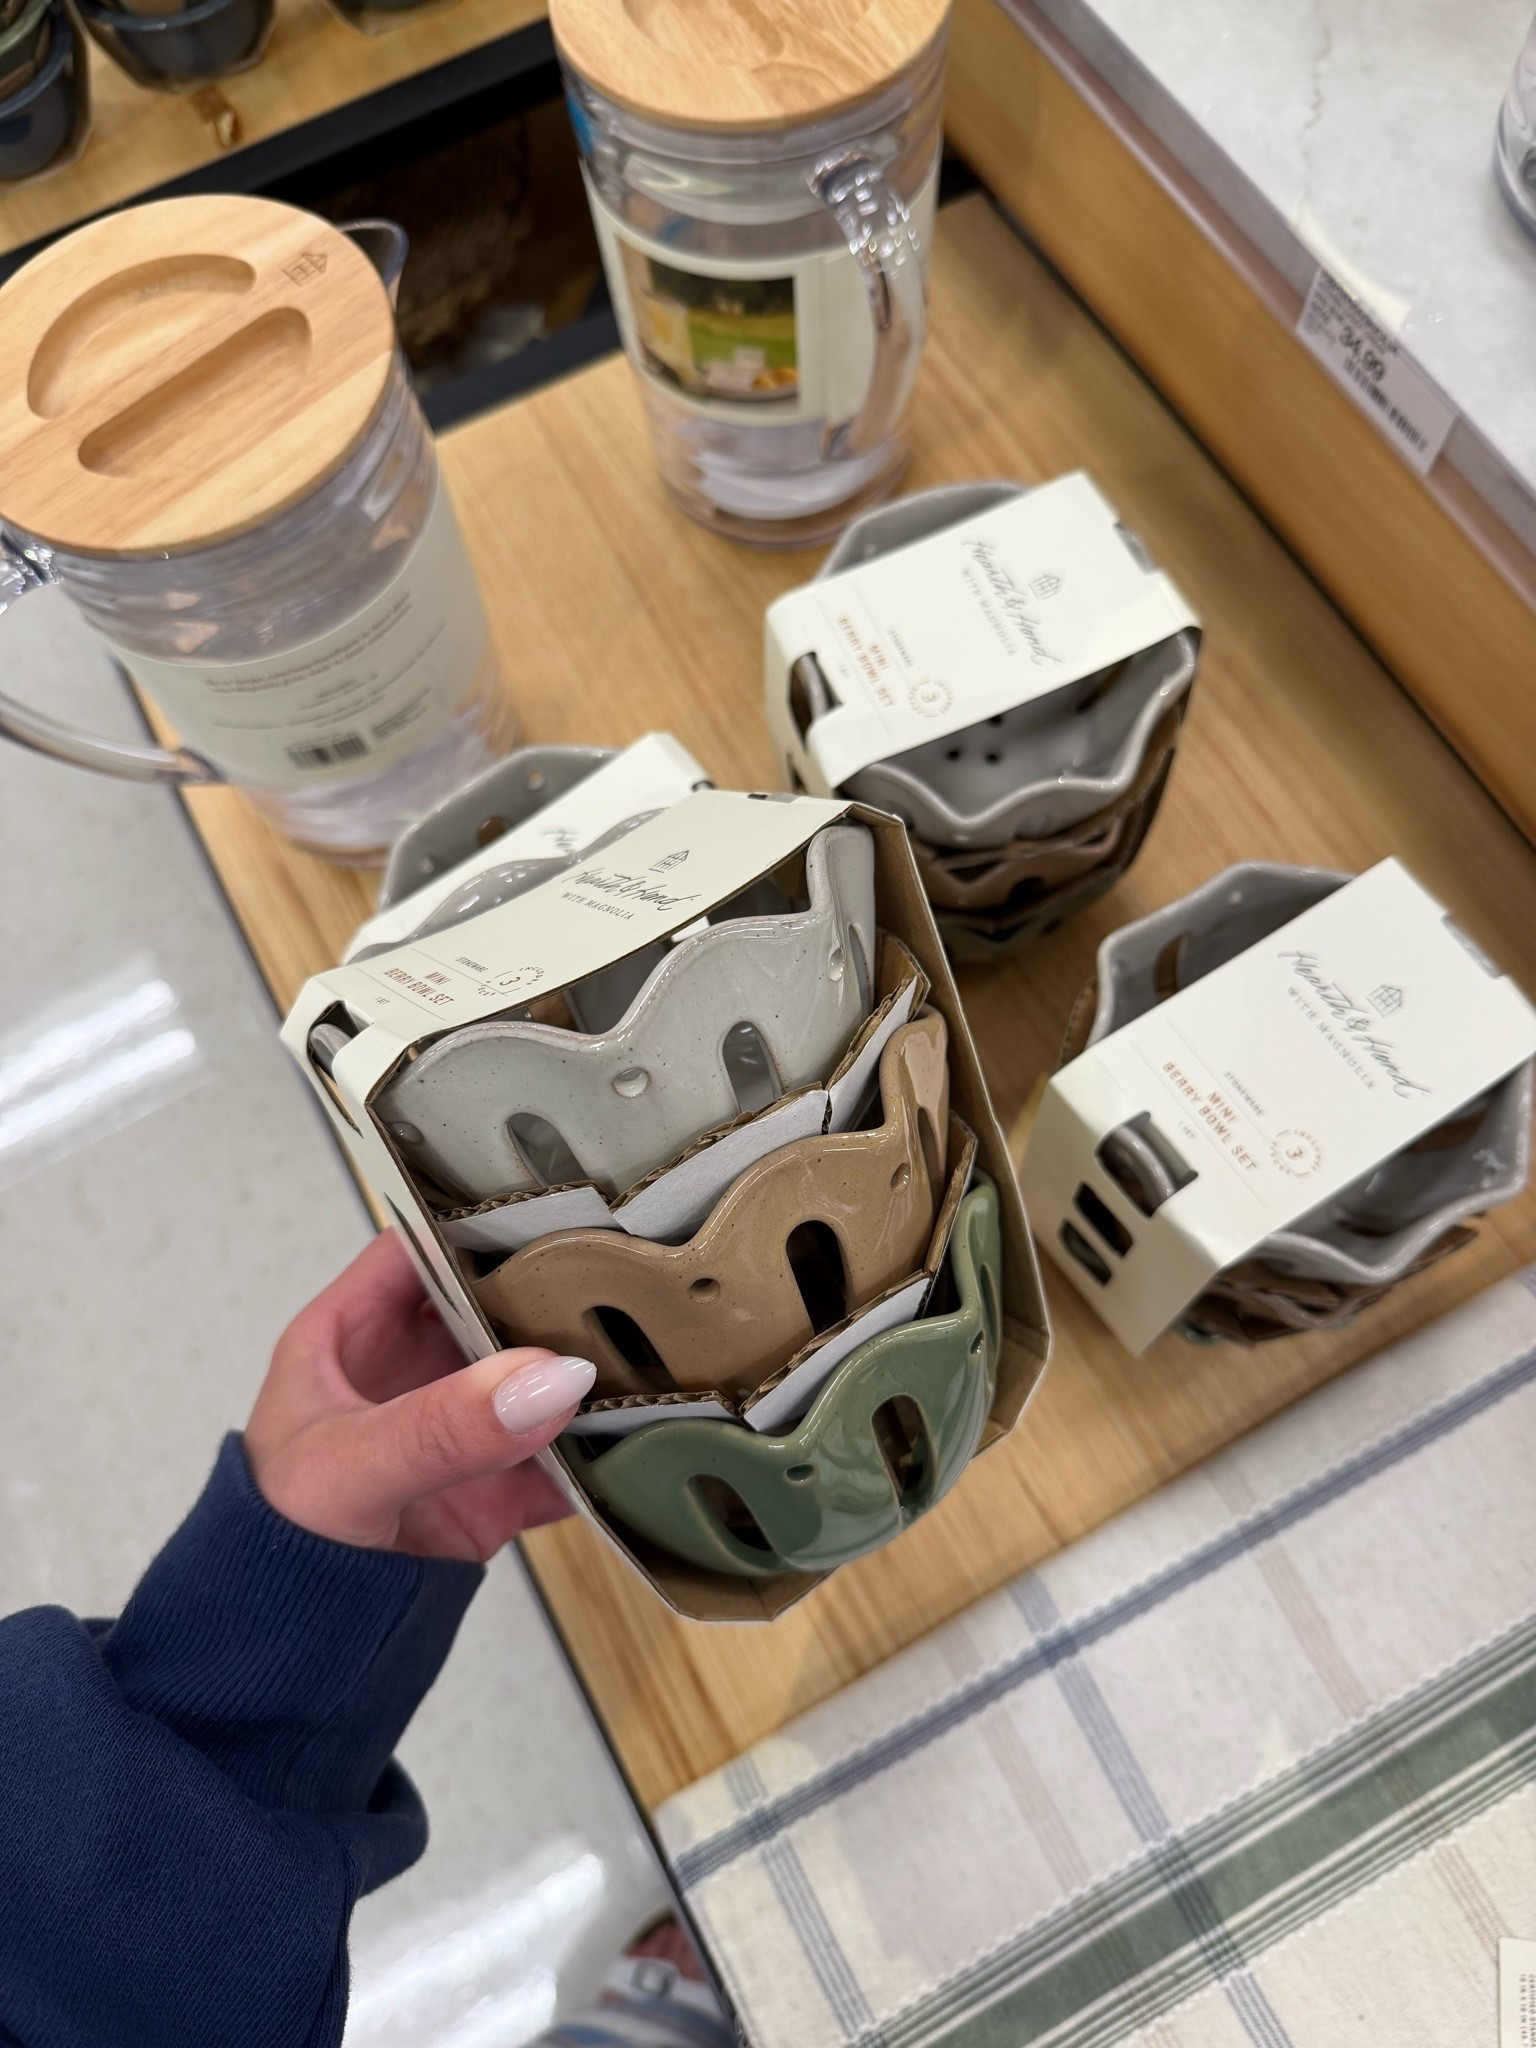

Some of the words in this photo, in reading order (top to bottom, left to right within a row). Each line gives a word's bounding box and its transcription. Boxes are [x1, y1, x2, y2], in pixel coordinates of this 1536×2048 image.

[961, 541, 1027, 600] Hearth
[1006, 614, 1064, 667] Hand
[561, 867, 647, 893] Hearth
[620, 884, 702, 911] Hand
[562, 892, 588, 905] WITH
[584, 899, 635, 920] MAGNOLIA
[424, 971, 453, 985] MINI
[456, 956, 488, 972] STONEWARE
[499, 976, 521, 986] 3
[384, 967, 416, 985] BERRY
[406, 981, 437, 998] BOWL
[428, 993, 455, 1006] SET
[1278, 952, 1368, 1021] Hearth
[1350, 1035, 1432, 1099] Hand
[1287, 986, 1317, 1021] WITH
[1316, 1021, 1375, 1090] MAGNOLIA
[1207, 1092, 1237, 1123] MINI
[1224, 1071, 1264, 1117] STONEWARE
[1162, 1061, 1201, 1103] BERRY
[1198, 1105, 1232, 1145] BOWL
[1231, 1145, 1257, 1170] SET
[1285, 1145, 1303, 1161] 3
